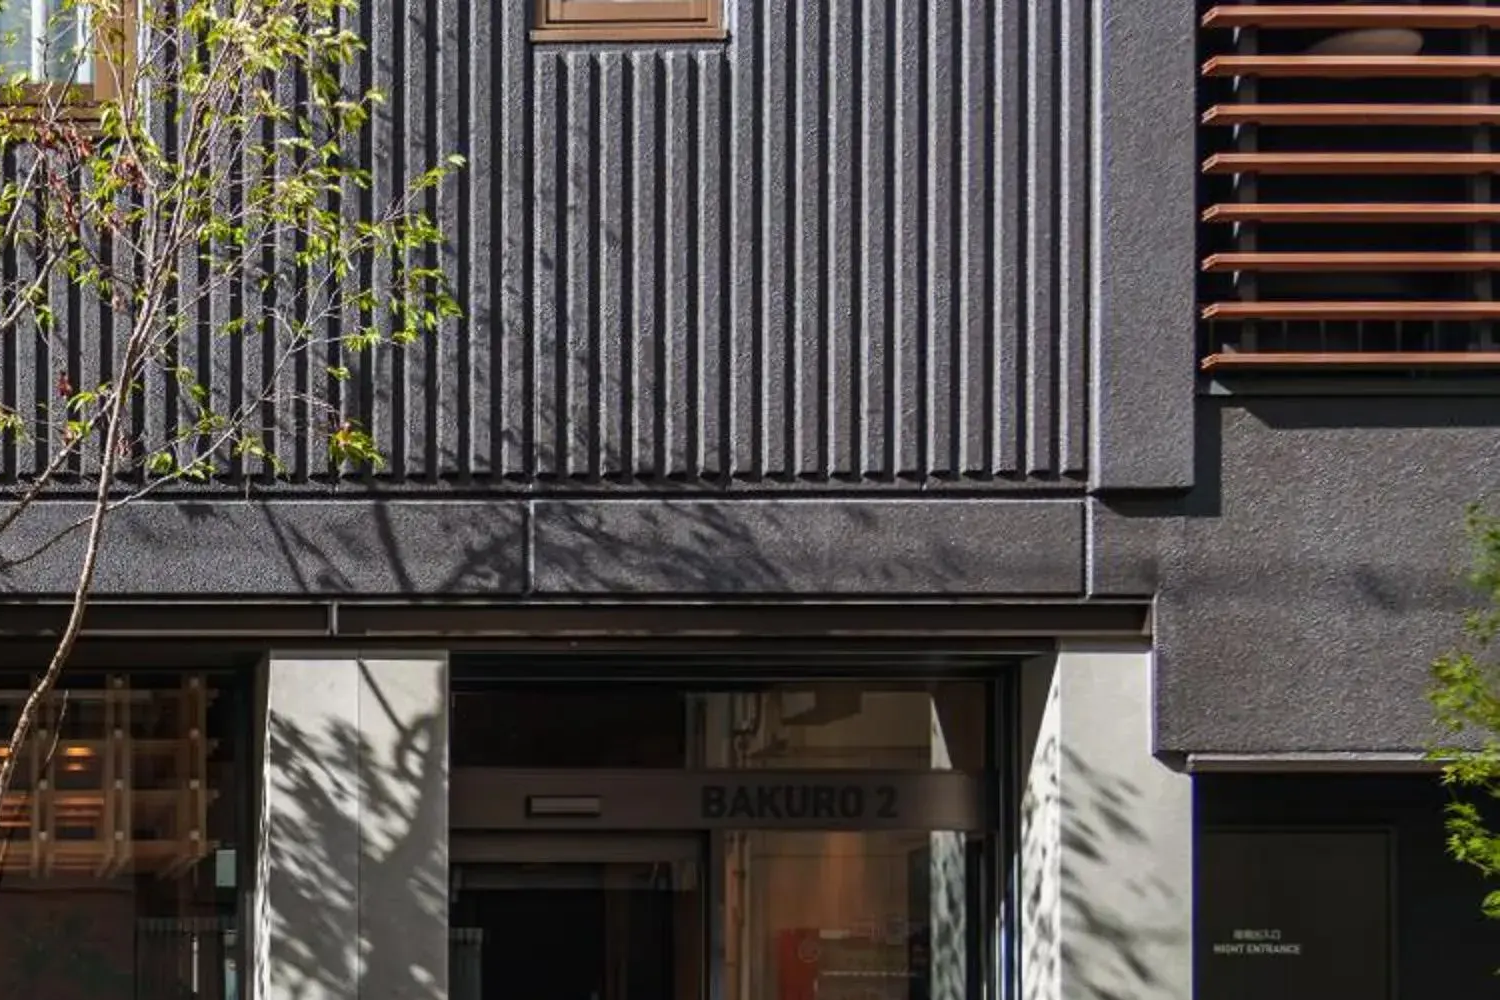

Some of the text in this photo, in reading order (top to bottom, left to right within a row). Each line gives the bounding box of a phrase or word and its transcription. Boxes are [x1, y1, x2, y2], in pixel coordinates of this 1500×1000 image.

[701, 785, 898, 818] BAKURO 2
[1246, 943, 1301, 954] ENTRANCE
